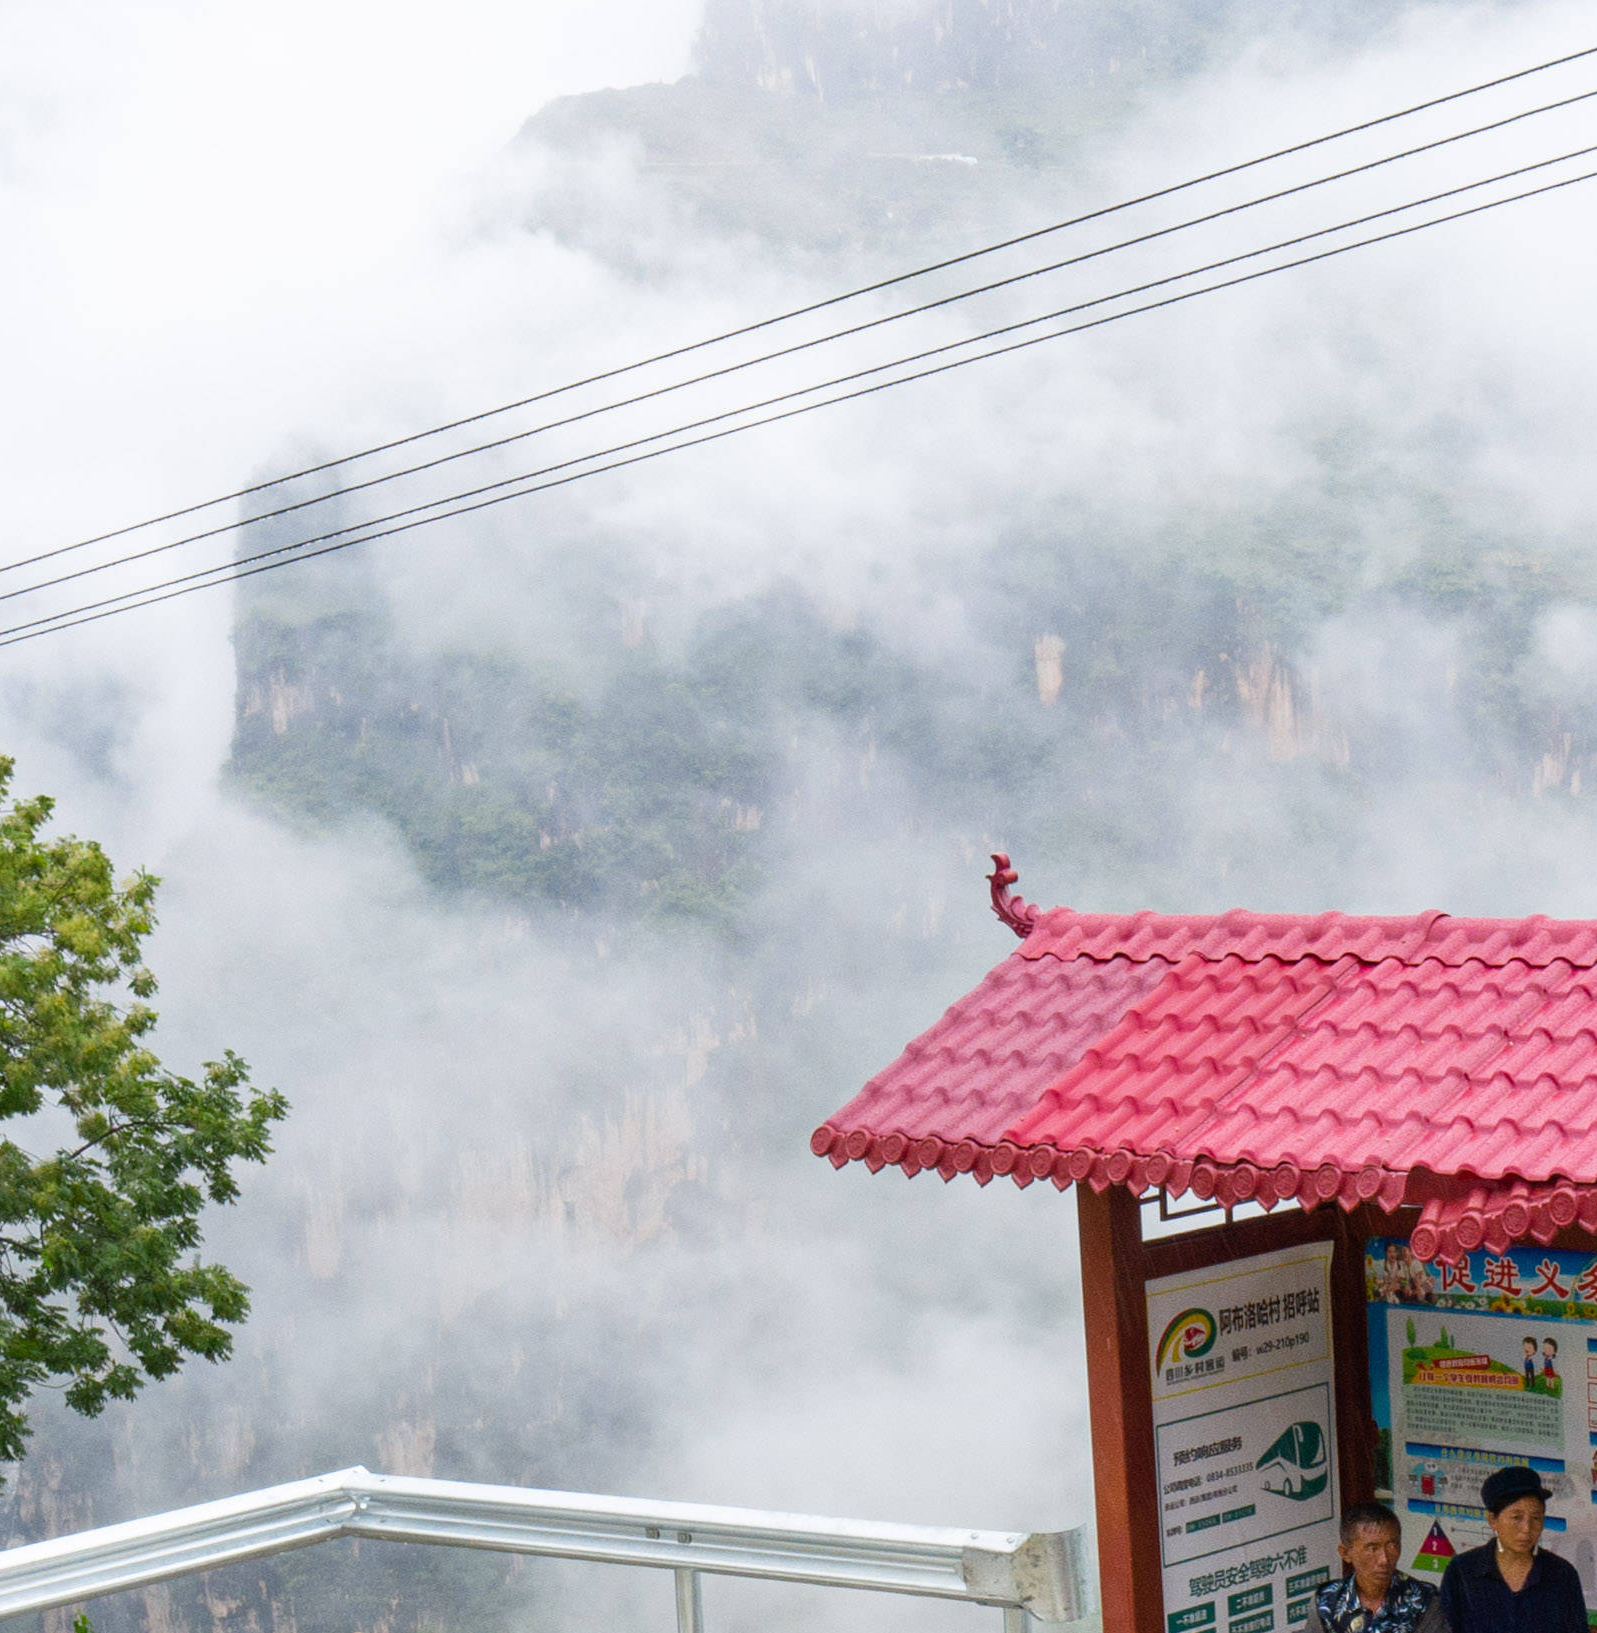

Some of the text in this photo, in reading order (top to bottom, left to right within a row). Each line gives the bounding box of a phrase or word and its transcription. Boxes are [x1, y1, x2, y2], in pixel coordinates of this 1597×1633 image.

[1219, 1286, 1320, 1336] 阿布洛哈村 招呼站
